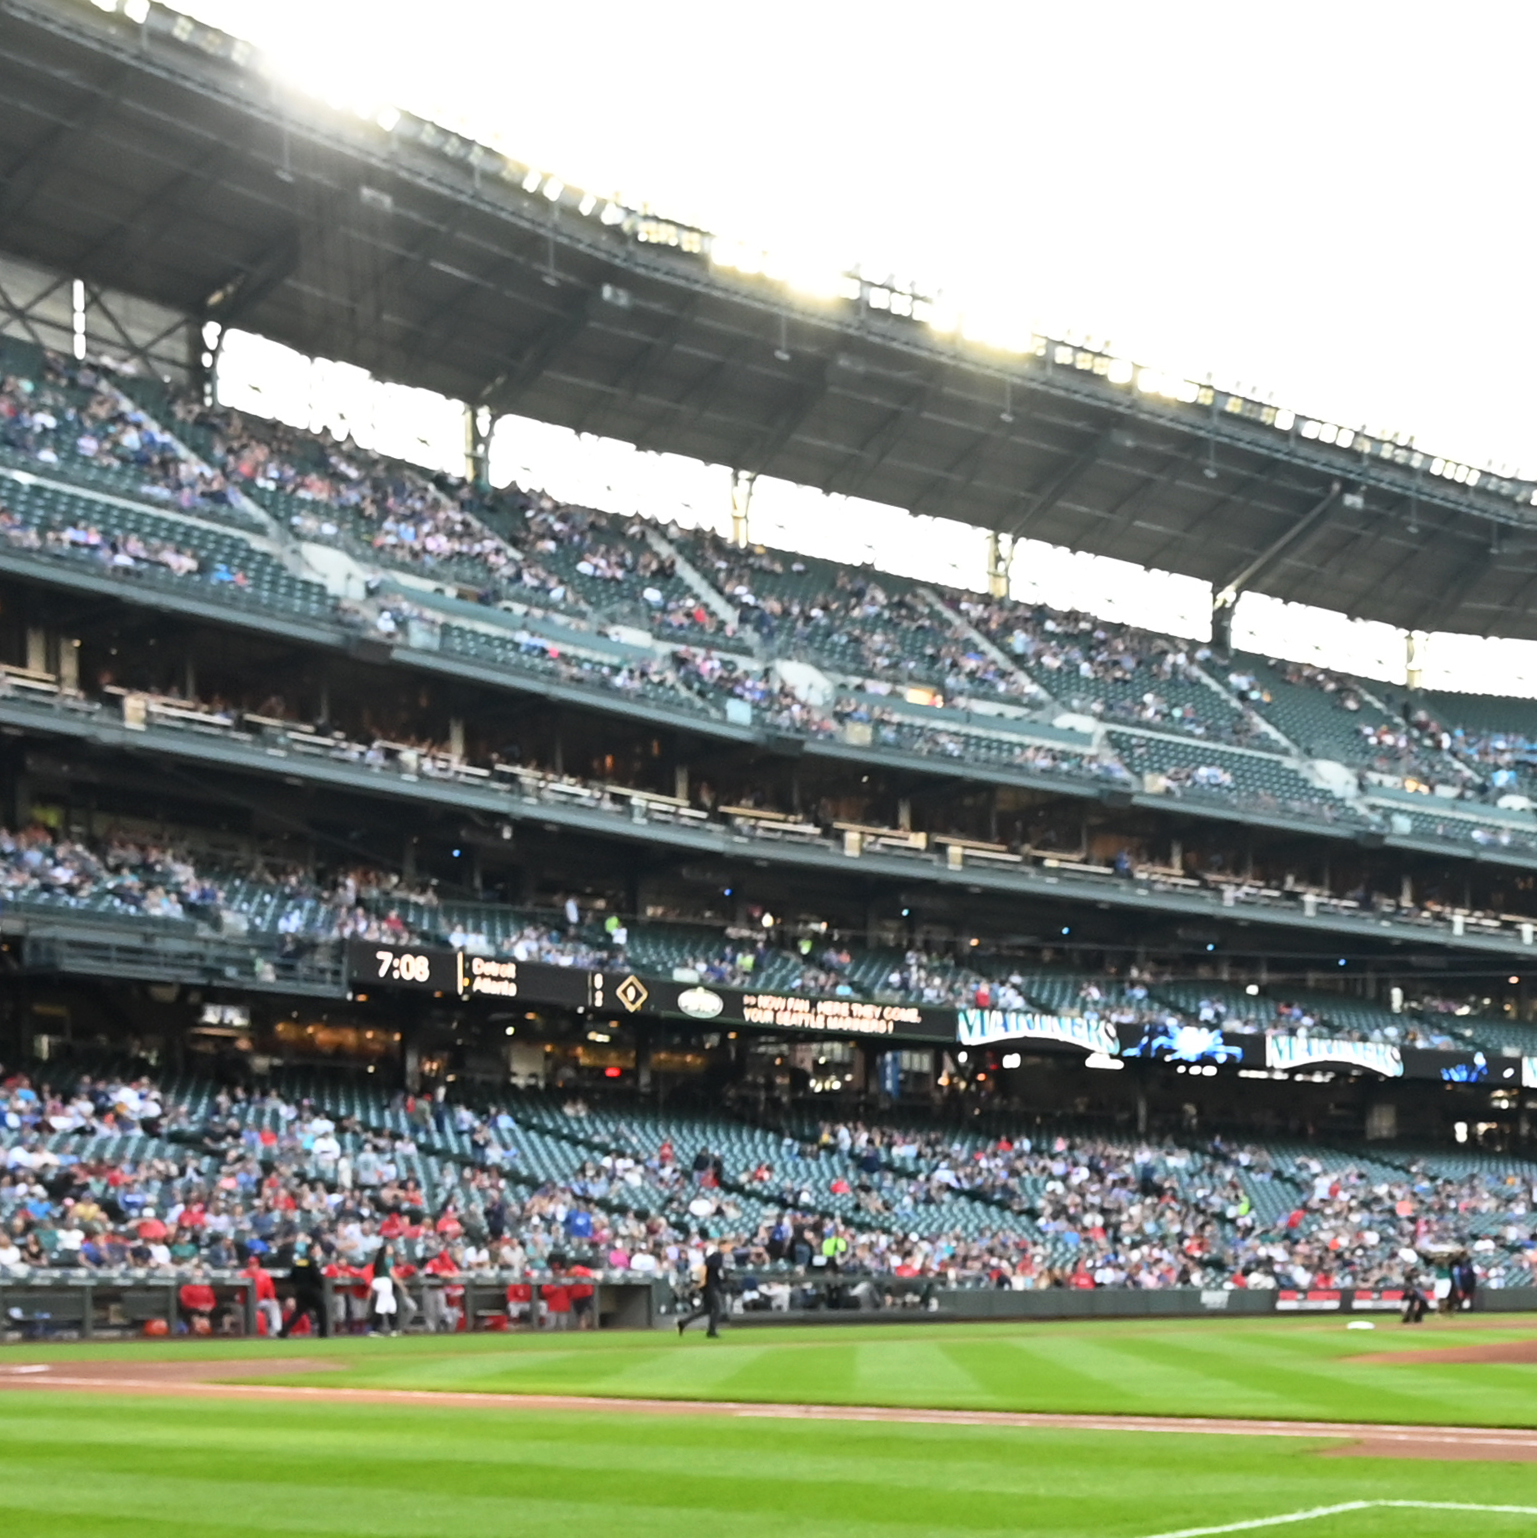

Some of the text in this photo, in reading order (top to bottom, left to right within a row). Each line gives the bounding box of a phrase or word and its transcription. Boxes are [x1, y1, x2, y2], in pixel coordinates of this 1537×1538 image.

[376, 950, 430, 982] 7:08
[956, 1008, 1121, 1055] MARINERS
[1266, 1035, 1404, 1077] MARINERS
